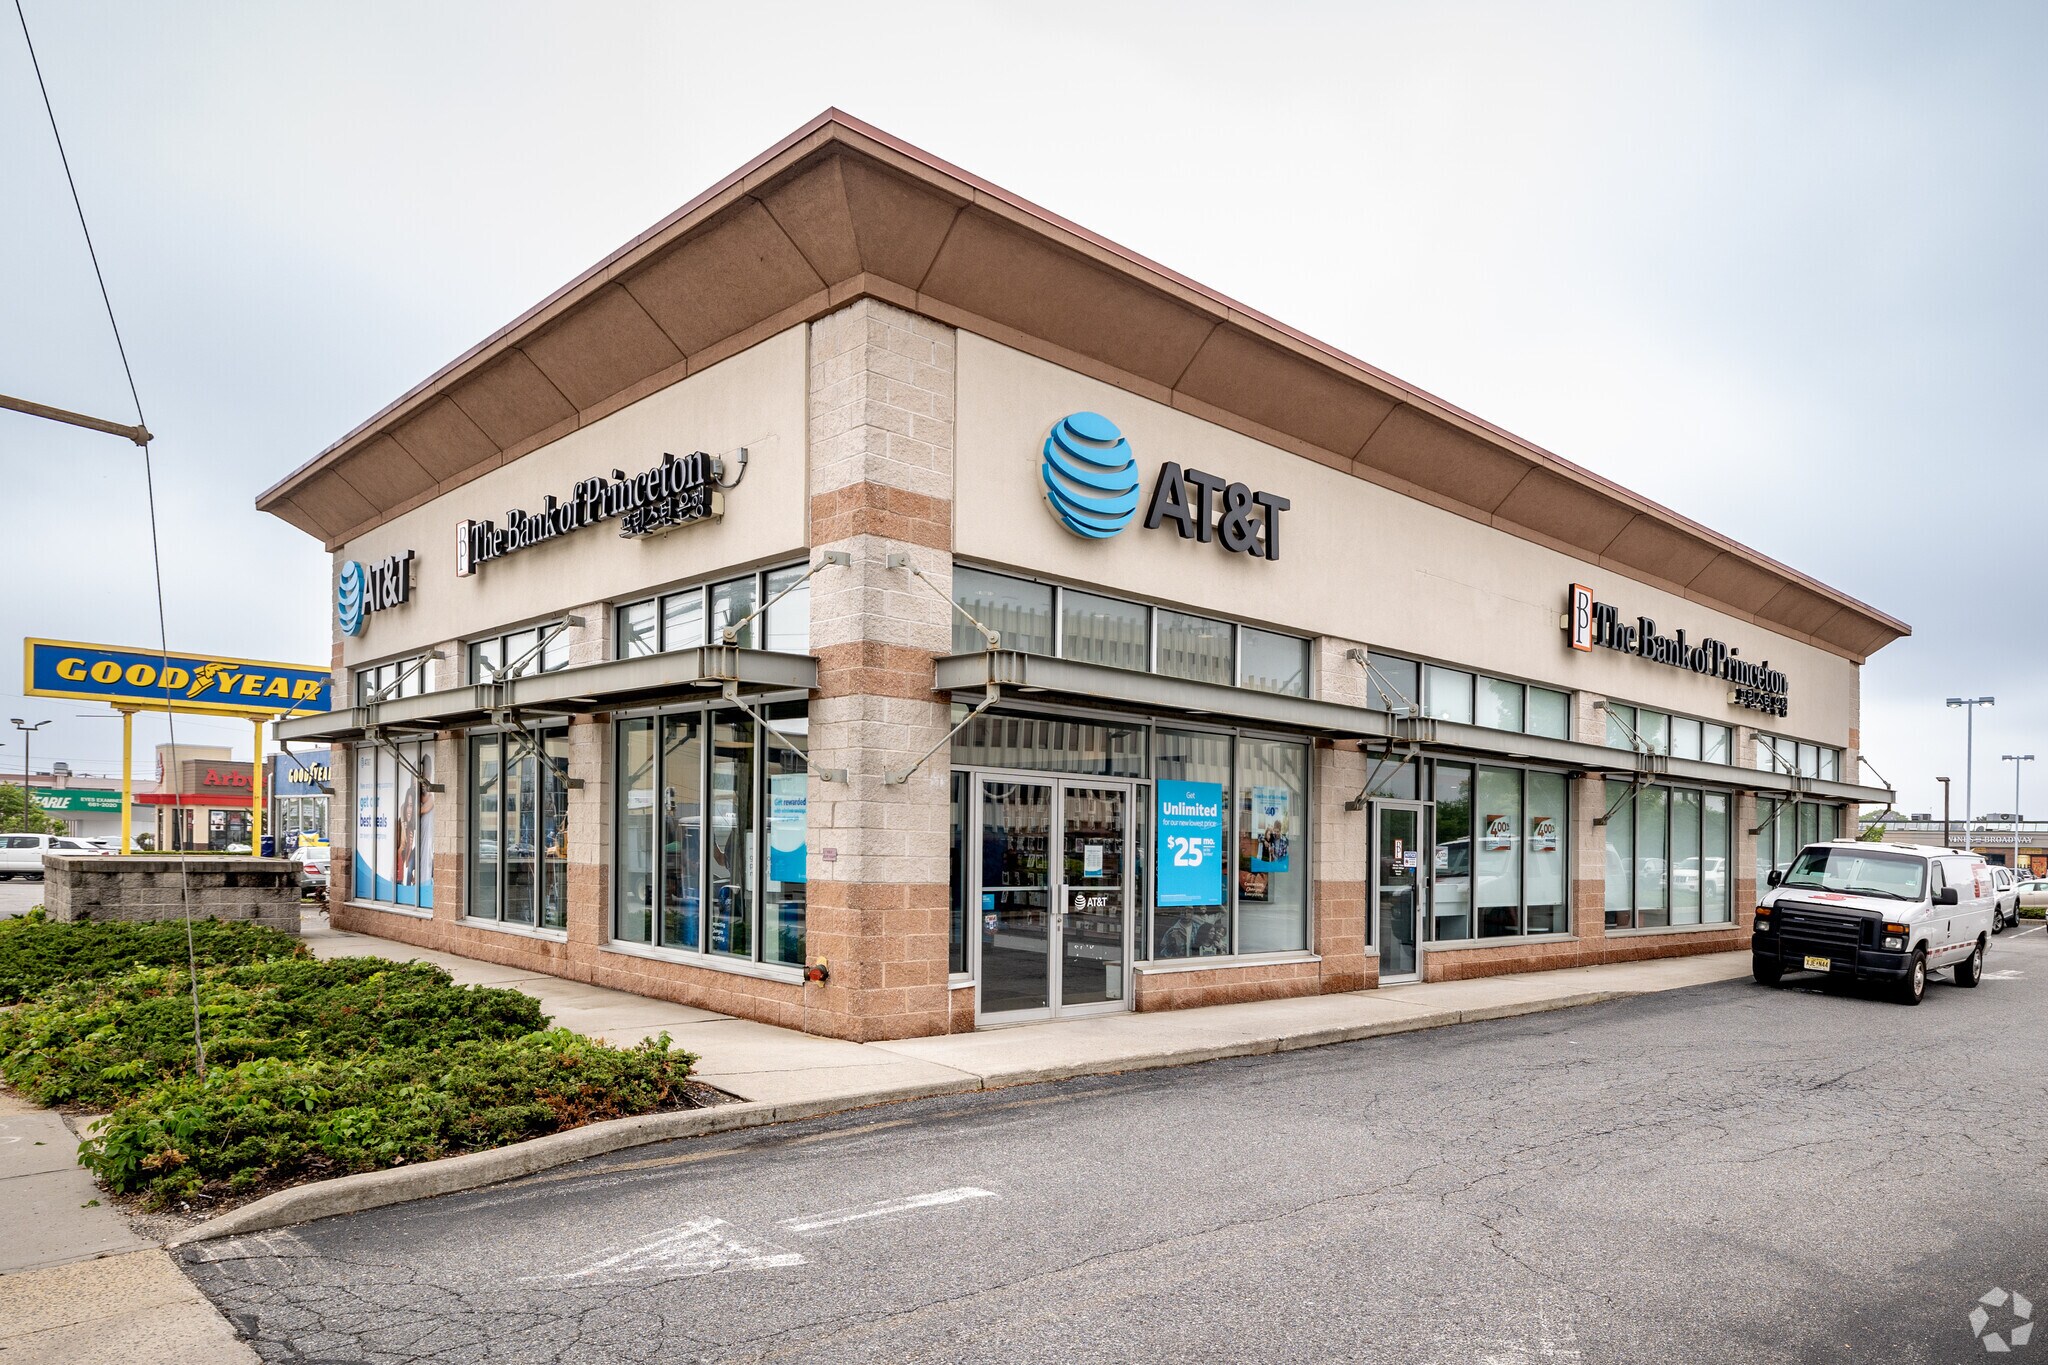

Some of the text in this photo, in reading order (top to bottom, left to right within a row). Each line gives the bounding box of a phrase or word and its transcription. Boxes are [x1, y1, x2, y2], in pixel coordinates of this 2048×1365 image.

[473, 451, 707, 564] The Bank of Princeton
[1143, 460, 1291, 561] AT&T
[361, 549, 415, 615] AT&T
[1594, 601, 1788, 696] The Bank of Princeton
[360, 796, 369, 811] get
[783, 797, 806, 806] rewarded
[1163, 802, 1217, 817] Unlimited
[360, 813, 371, 827] best
[1188, 819, 1203, 827] lowest
[1167, 834, 1203, 867] $25
[1087, 897, 1108, 907] AT&T
